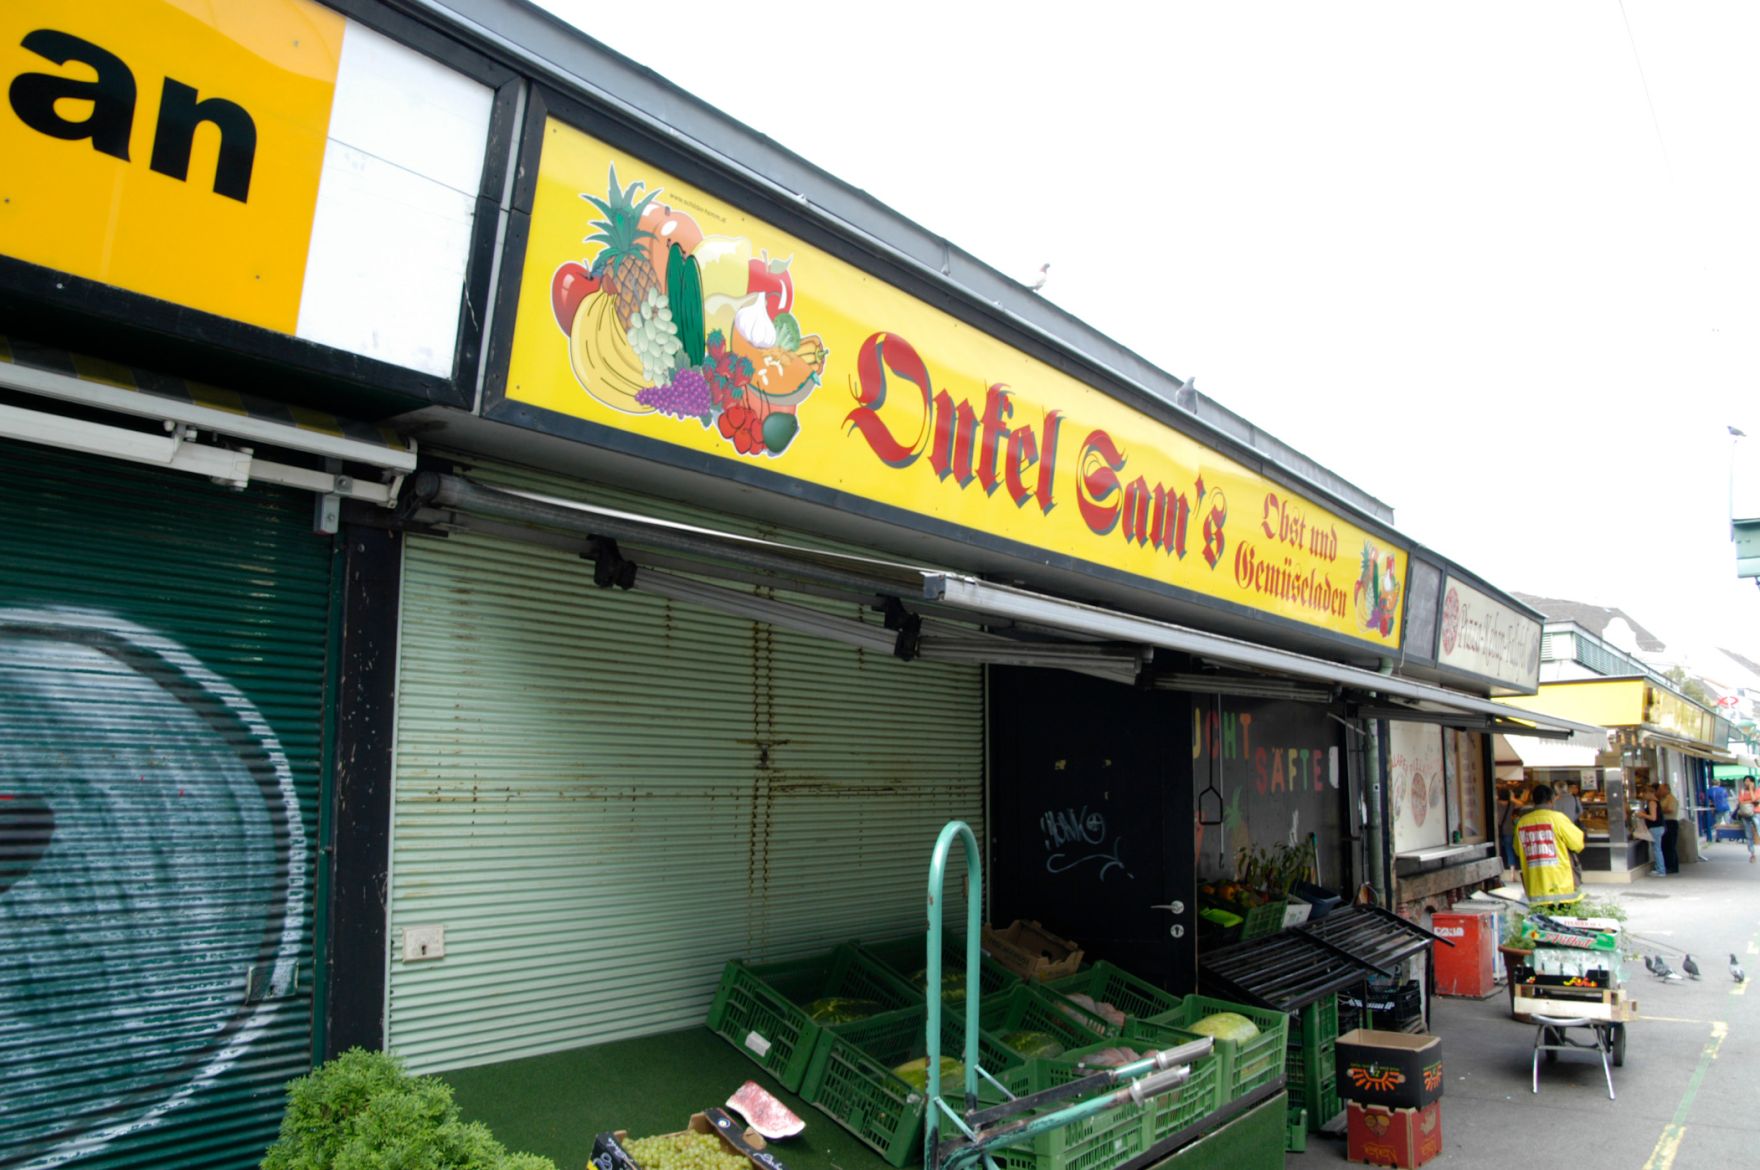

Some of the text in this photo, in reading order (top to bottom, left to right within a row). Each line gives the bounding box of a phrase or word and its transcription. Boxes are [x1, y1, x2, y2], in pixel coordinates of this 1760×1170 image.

[9, 28, 258, 203] an
[841, 331, 1228, 571] Onkel Sam's
[1262, 492, 1338, 563] Obst und
[1234, 540, 1348, 619] Gemüseladen
[1255, 746, 1325, 796] SÄFTE
